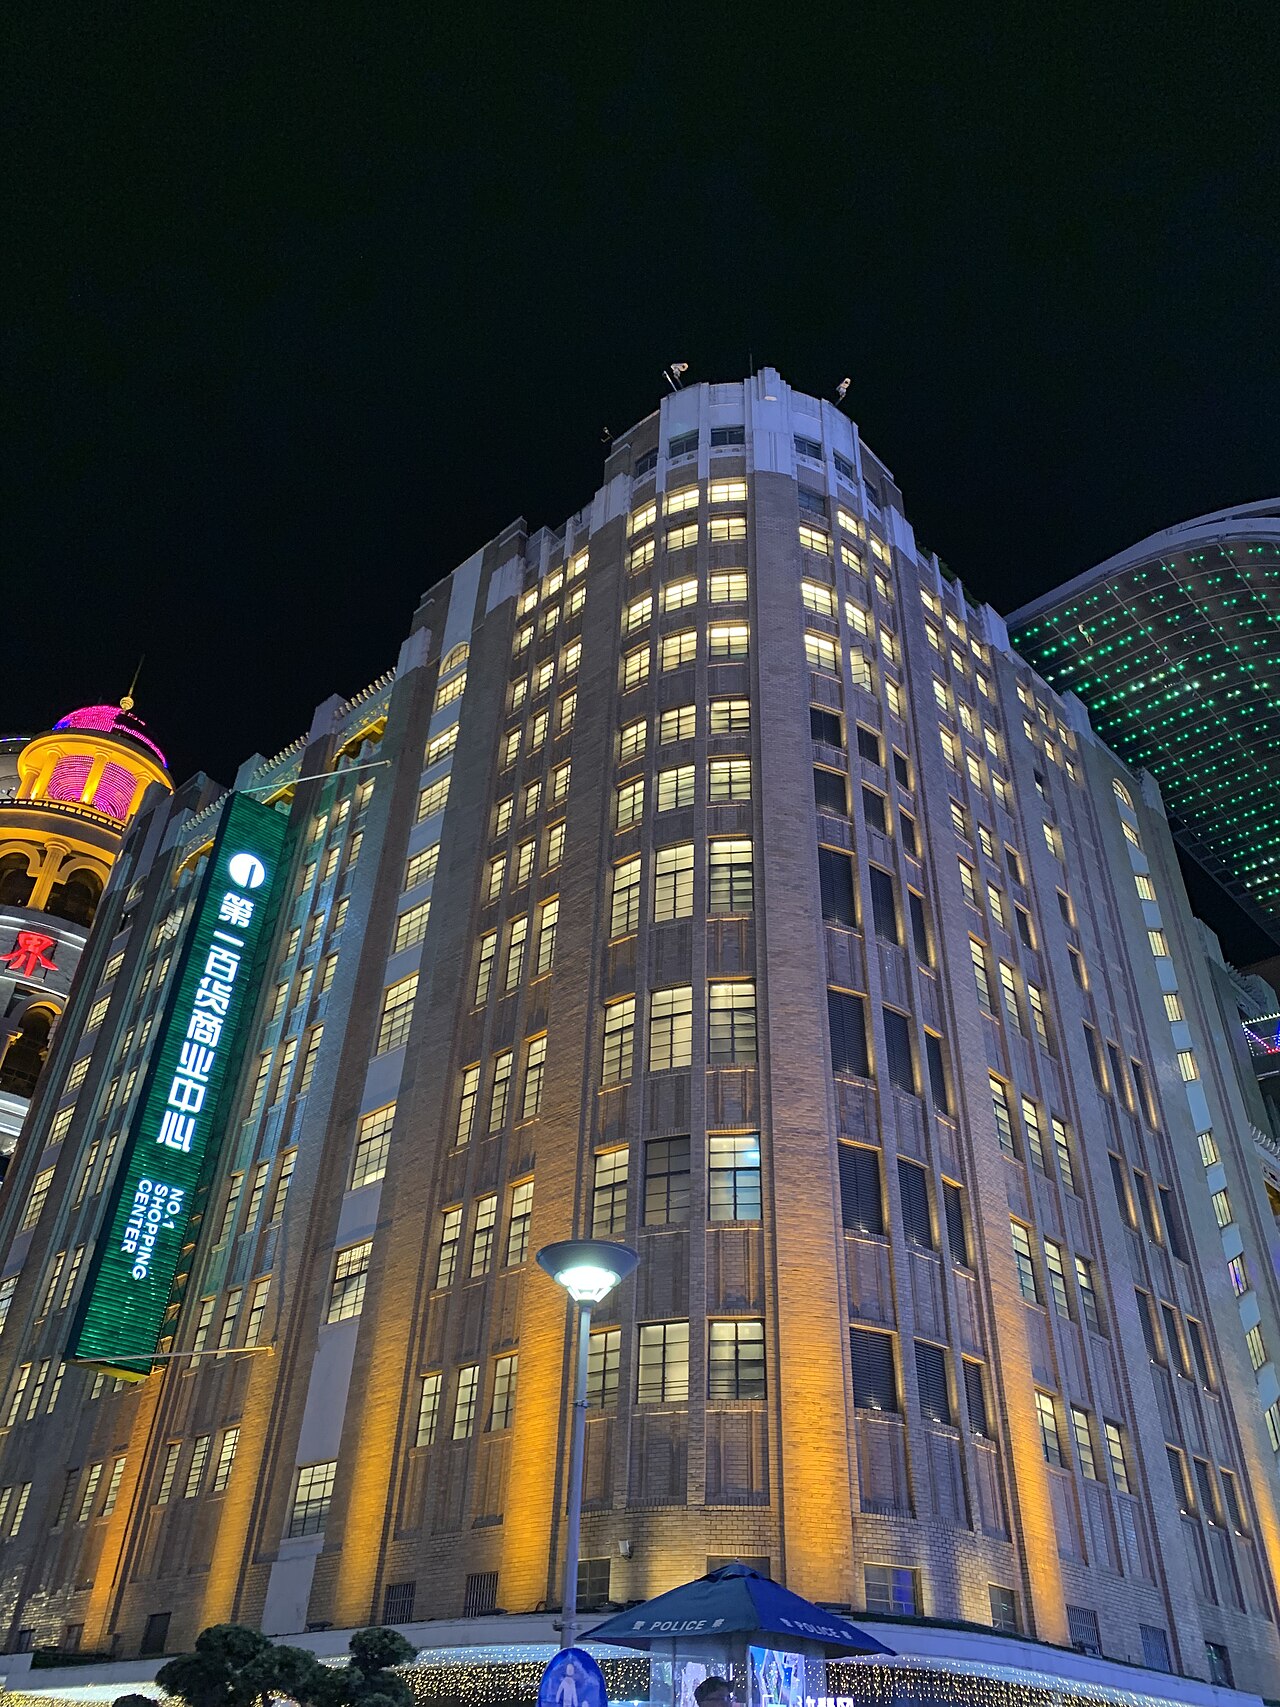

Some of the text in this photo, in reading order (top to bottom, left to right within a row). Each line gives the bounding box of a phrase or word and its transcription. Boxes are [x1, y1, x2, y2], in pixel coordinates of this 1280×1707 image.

[156, 891, 255, 1153] 第一百货商业中心
[121, 1179, 153, 1254] CENTER
[132, 1183, 169, 1280] SHOPPING
[162, 1187, 184, 1230] NO.1
[649, 1619, 708, 1631] POLICE
[794, 1620, 841, 1639] POLICE
